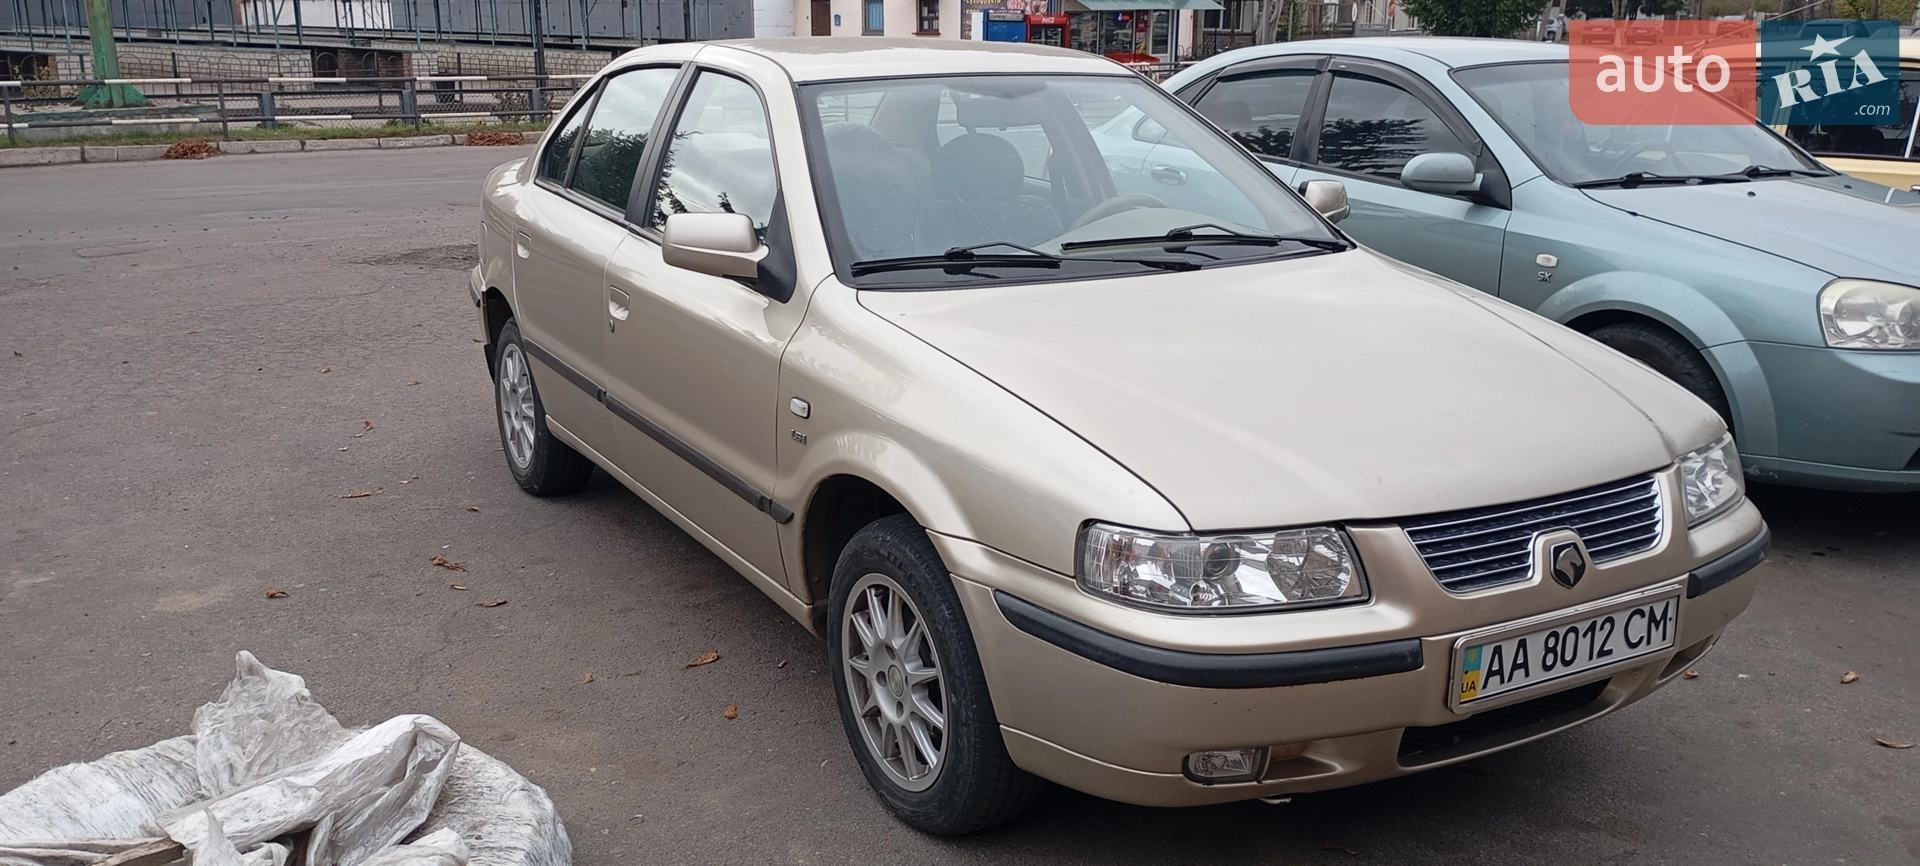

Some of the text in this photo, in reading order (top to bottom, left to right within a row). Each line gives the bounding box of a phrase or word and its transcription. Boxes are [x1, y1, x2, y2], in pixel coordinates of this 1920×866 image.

[1537, 271, 1552, 283] SX
[1481, 600, 1670, 690] AA 8012 CM
[1460, 681, 1477, 694] UA
